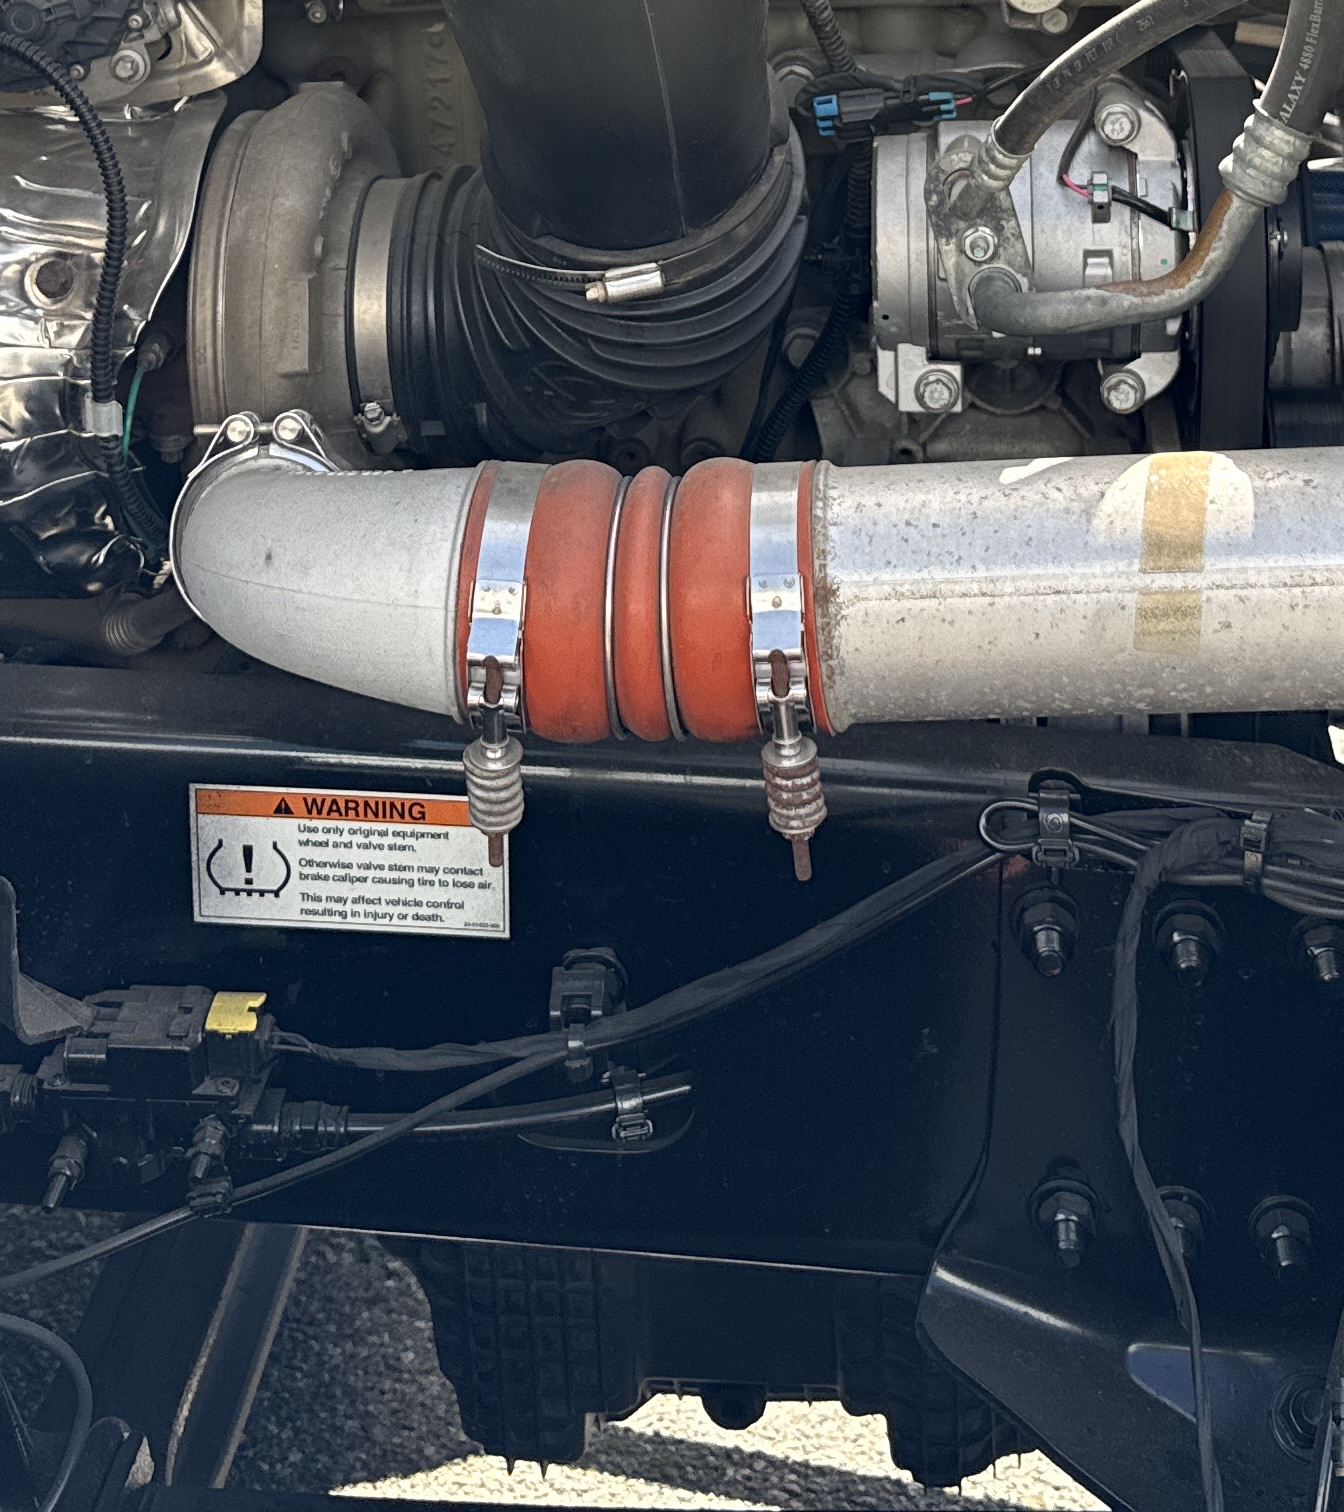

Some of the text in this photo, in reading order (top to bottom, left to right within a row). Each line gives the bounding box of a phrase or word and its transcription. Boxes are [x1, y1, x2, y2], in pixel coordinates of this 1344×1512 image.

[1298, 45, 1315, 70] 4880
[302, 796, 426, 821] WARNING
[297, 823, 449, 841] Use only original equipment
[298, 838, 417, 852] wheel and valve stem.
[298, 857, 484, 876] Otherwise valve stem may contact
[299, 871, 330, 882] brake
[332, 873, 368, 885] caliper
[371, 875, 415, 887] causing
[417, 877, 435, 886] tire
[438, 878, 449, 887] to
[452, 879, 475, 889] lose
[299, 892, 465, 910] This may affect vehicle control
[300, 906, 445, 923] resulting in injury or death.
